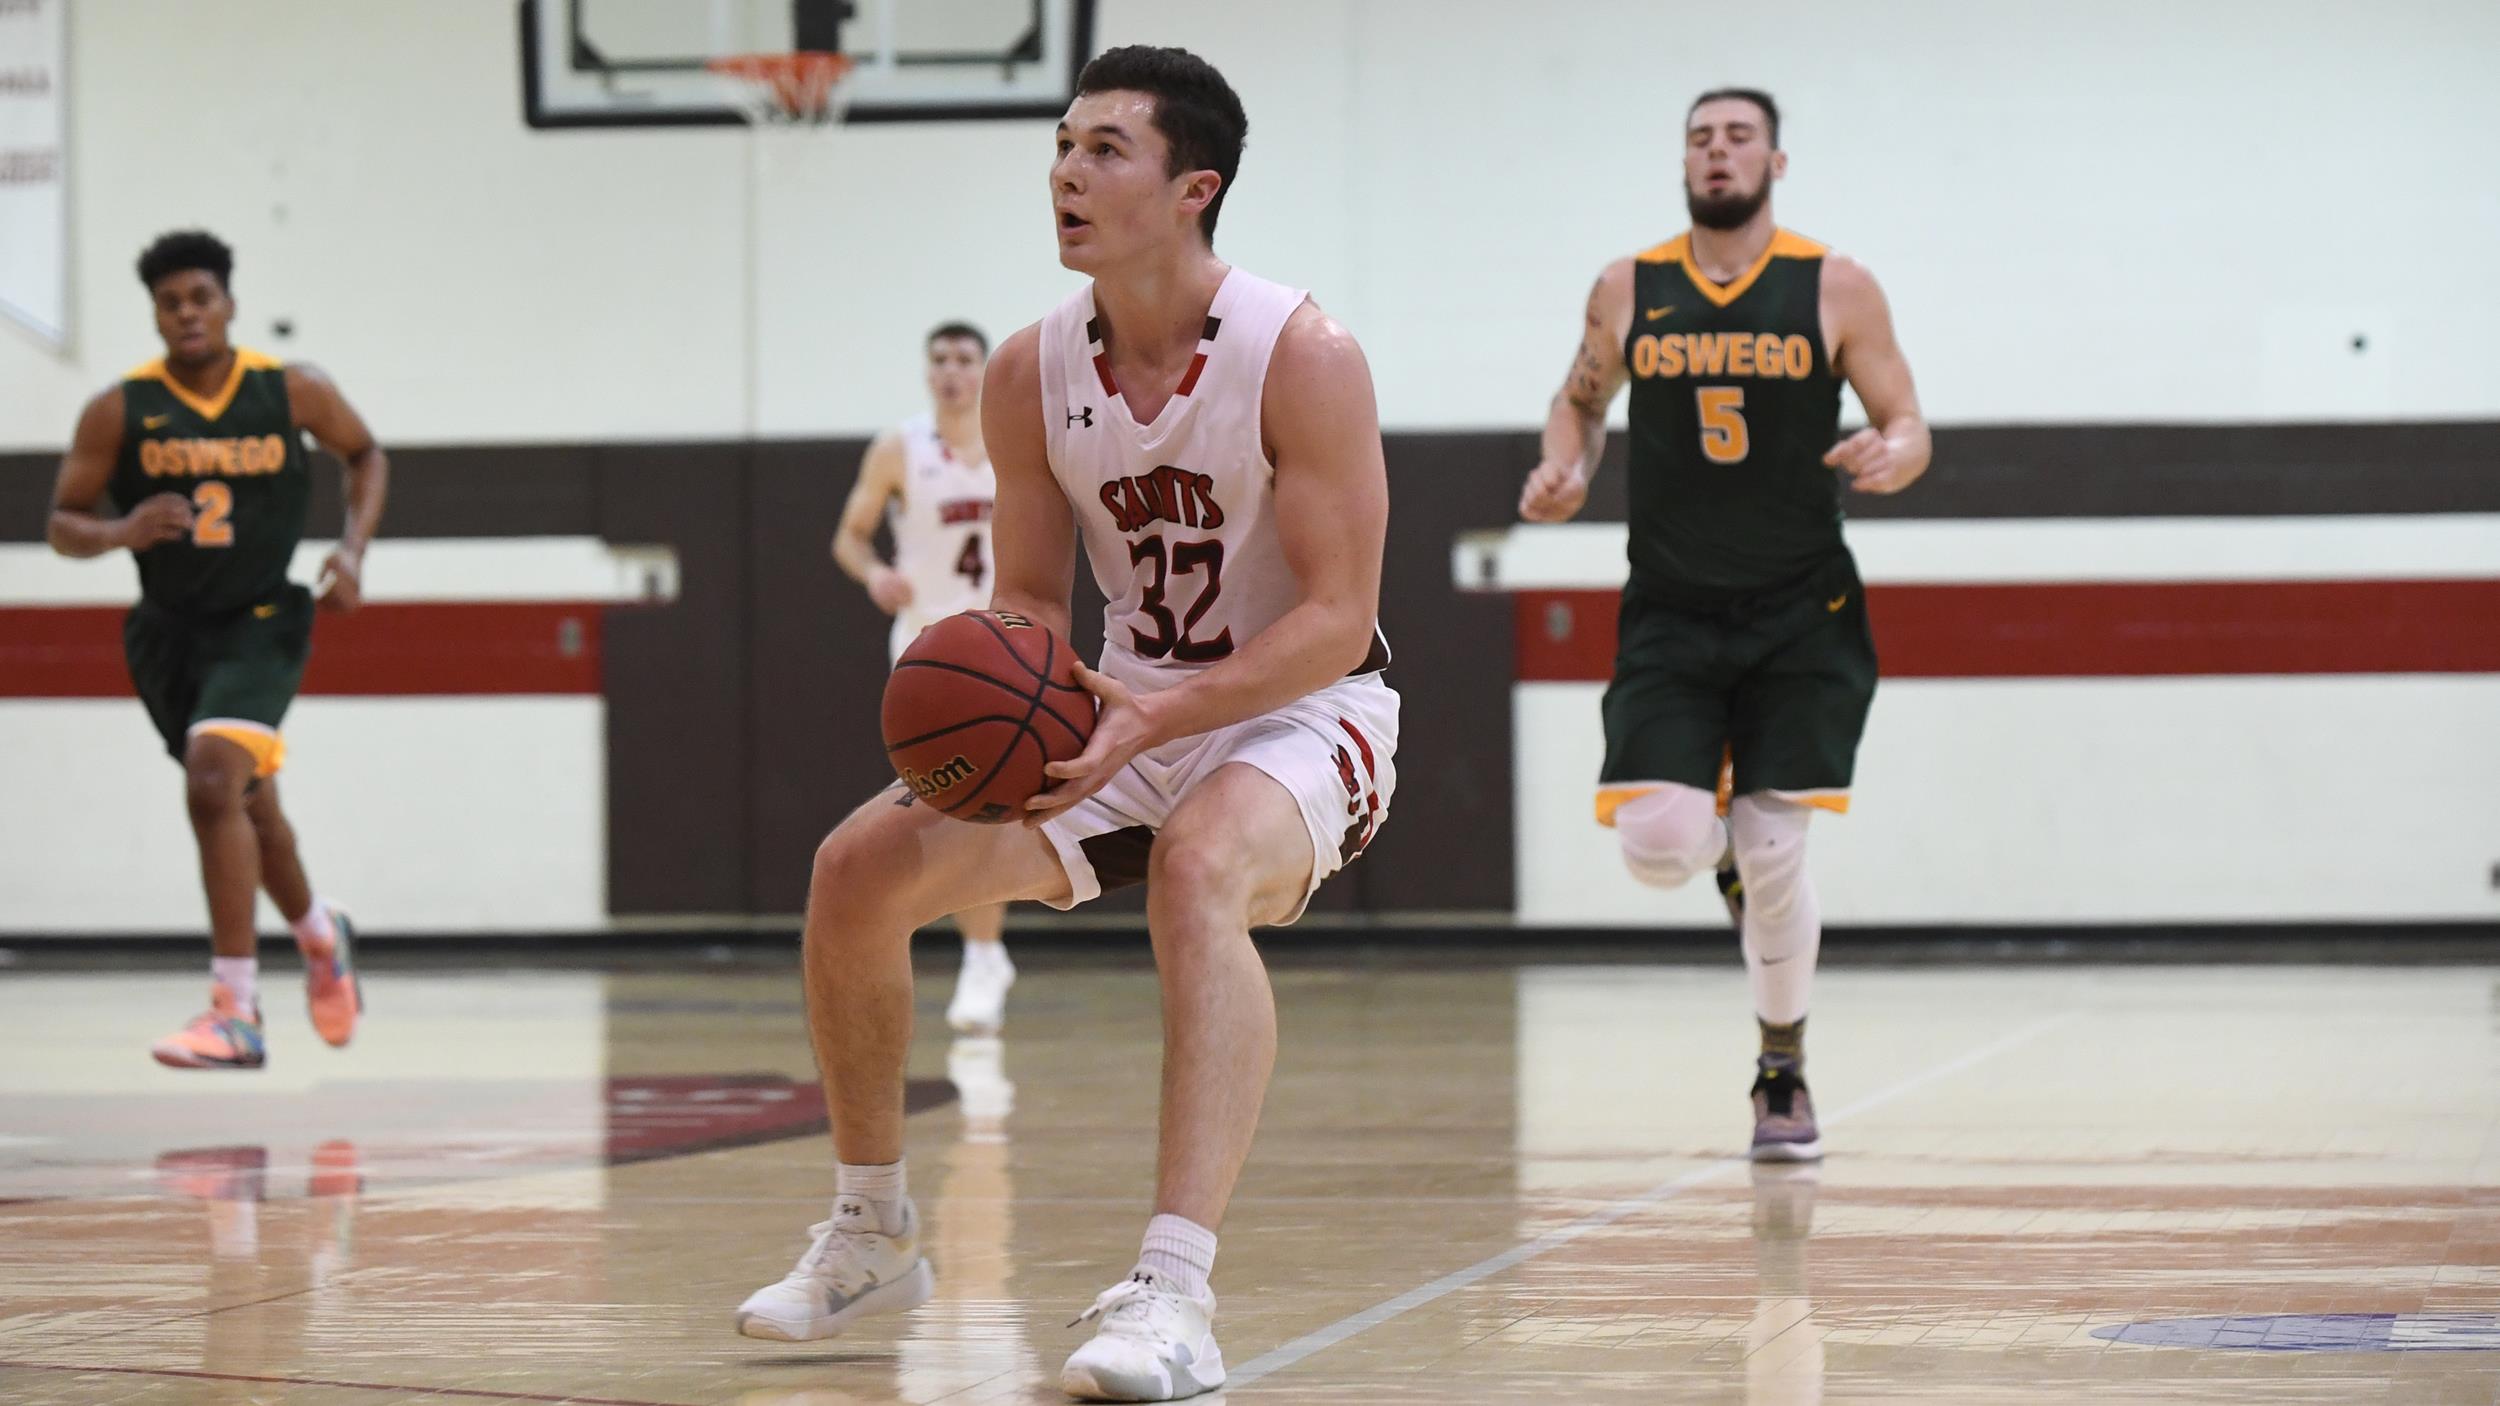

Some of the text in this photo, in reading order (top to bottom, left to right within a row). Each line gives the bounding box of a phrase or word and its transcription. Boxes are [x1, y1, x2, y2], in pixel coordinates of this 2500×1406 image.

[1633, 332, 1813, 379] OSWEGO
[140, 433, 286, 477] OSWEGO
[1696, 386, 1750, 464] 5
[192, 480, 233, 546] 2
[1100, 465, 1225, 532] SAINTS
[955, 533, 985, 588] 4
[1126, 534, 1235, 663] 32
